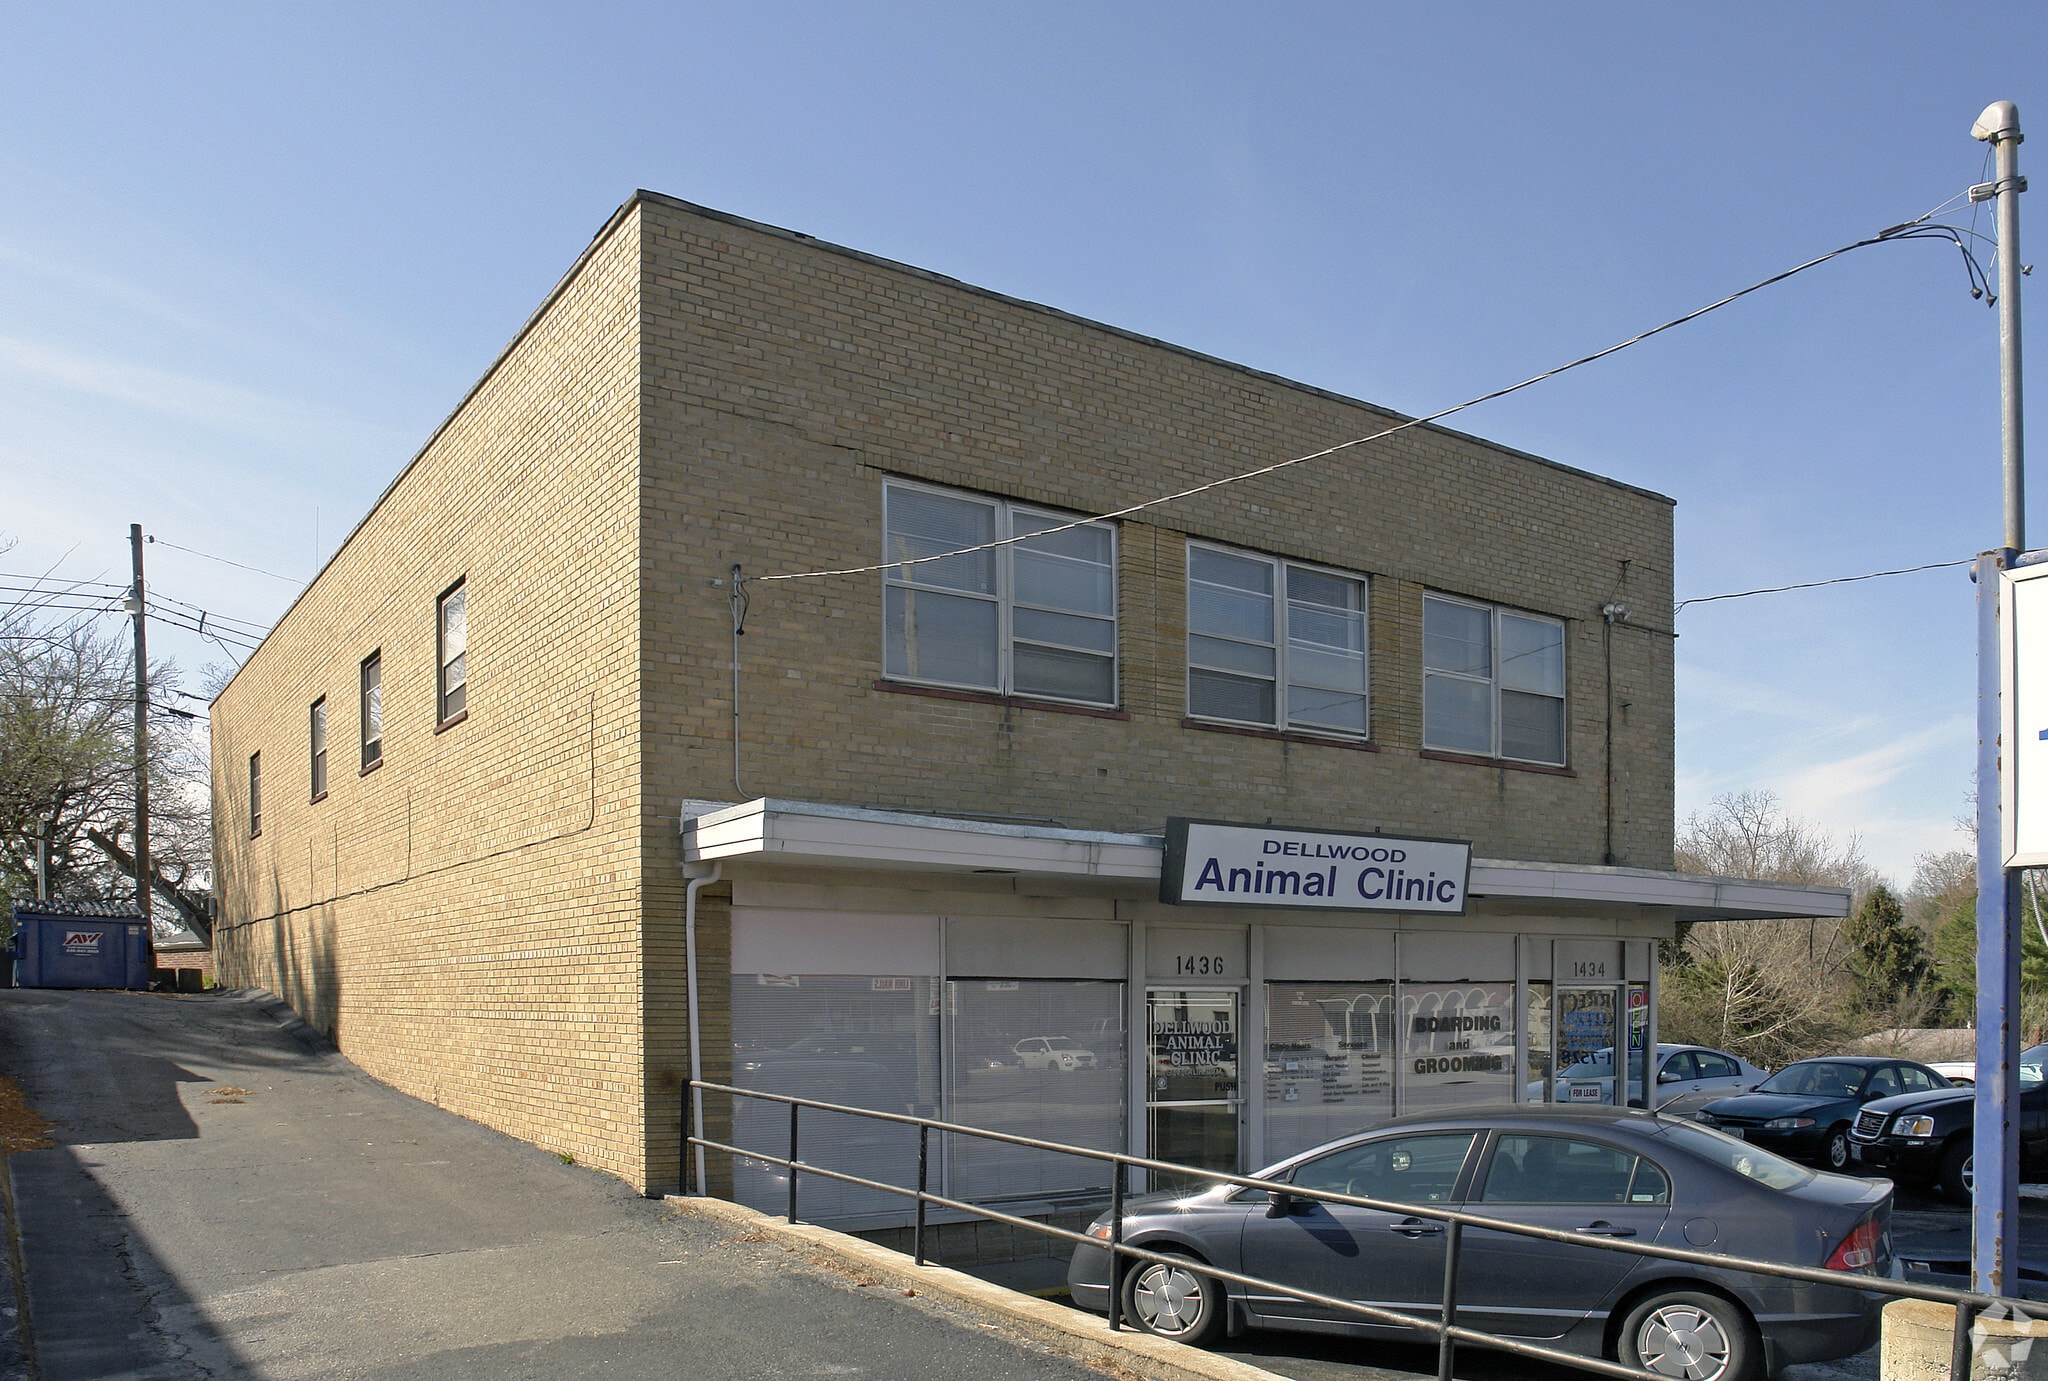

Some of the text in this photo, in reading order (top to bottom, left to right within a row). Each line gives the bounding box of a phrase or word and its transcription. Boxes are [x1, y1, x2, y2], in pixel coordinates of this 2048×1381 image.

[1262, 840, 1407, 863] DELLWOOD
[1194, 857, 1456, 903] Animal Clinic
[1176, 955, 1224, 975] 1436
[1574, 961, 1605, 977] 1434
[1153, 1020, 1232, 1035] DELLWOOD
[1415, 1015, 1501, 1033] BOARDING
[1632, 993, 1642, 1047] OPEN
[1166, 1035, 1224, 1050] ANIMAL
[1449, 1038, 1470, 1050] and
[1170, 1050, 1221, 1066] CLINIC
[1414, 1055, 1502, 1074] GROOMING
[1214, 1081, 1237, 1093] PUSH
[1573, 1088, 1598, 1097] FOR LEASE
